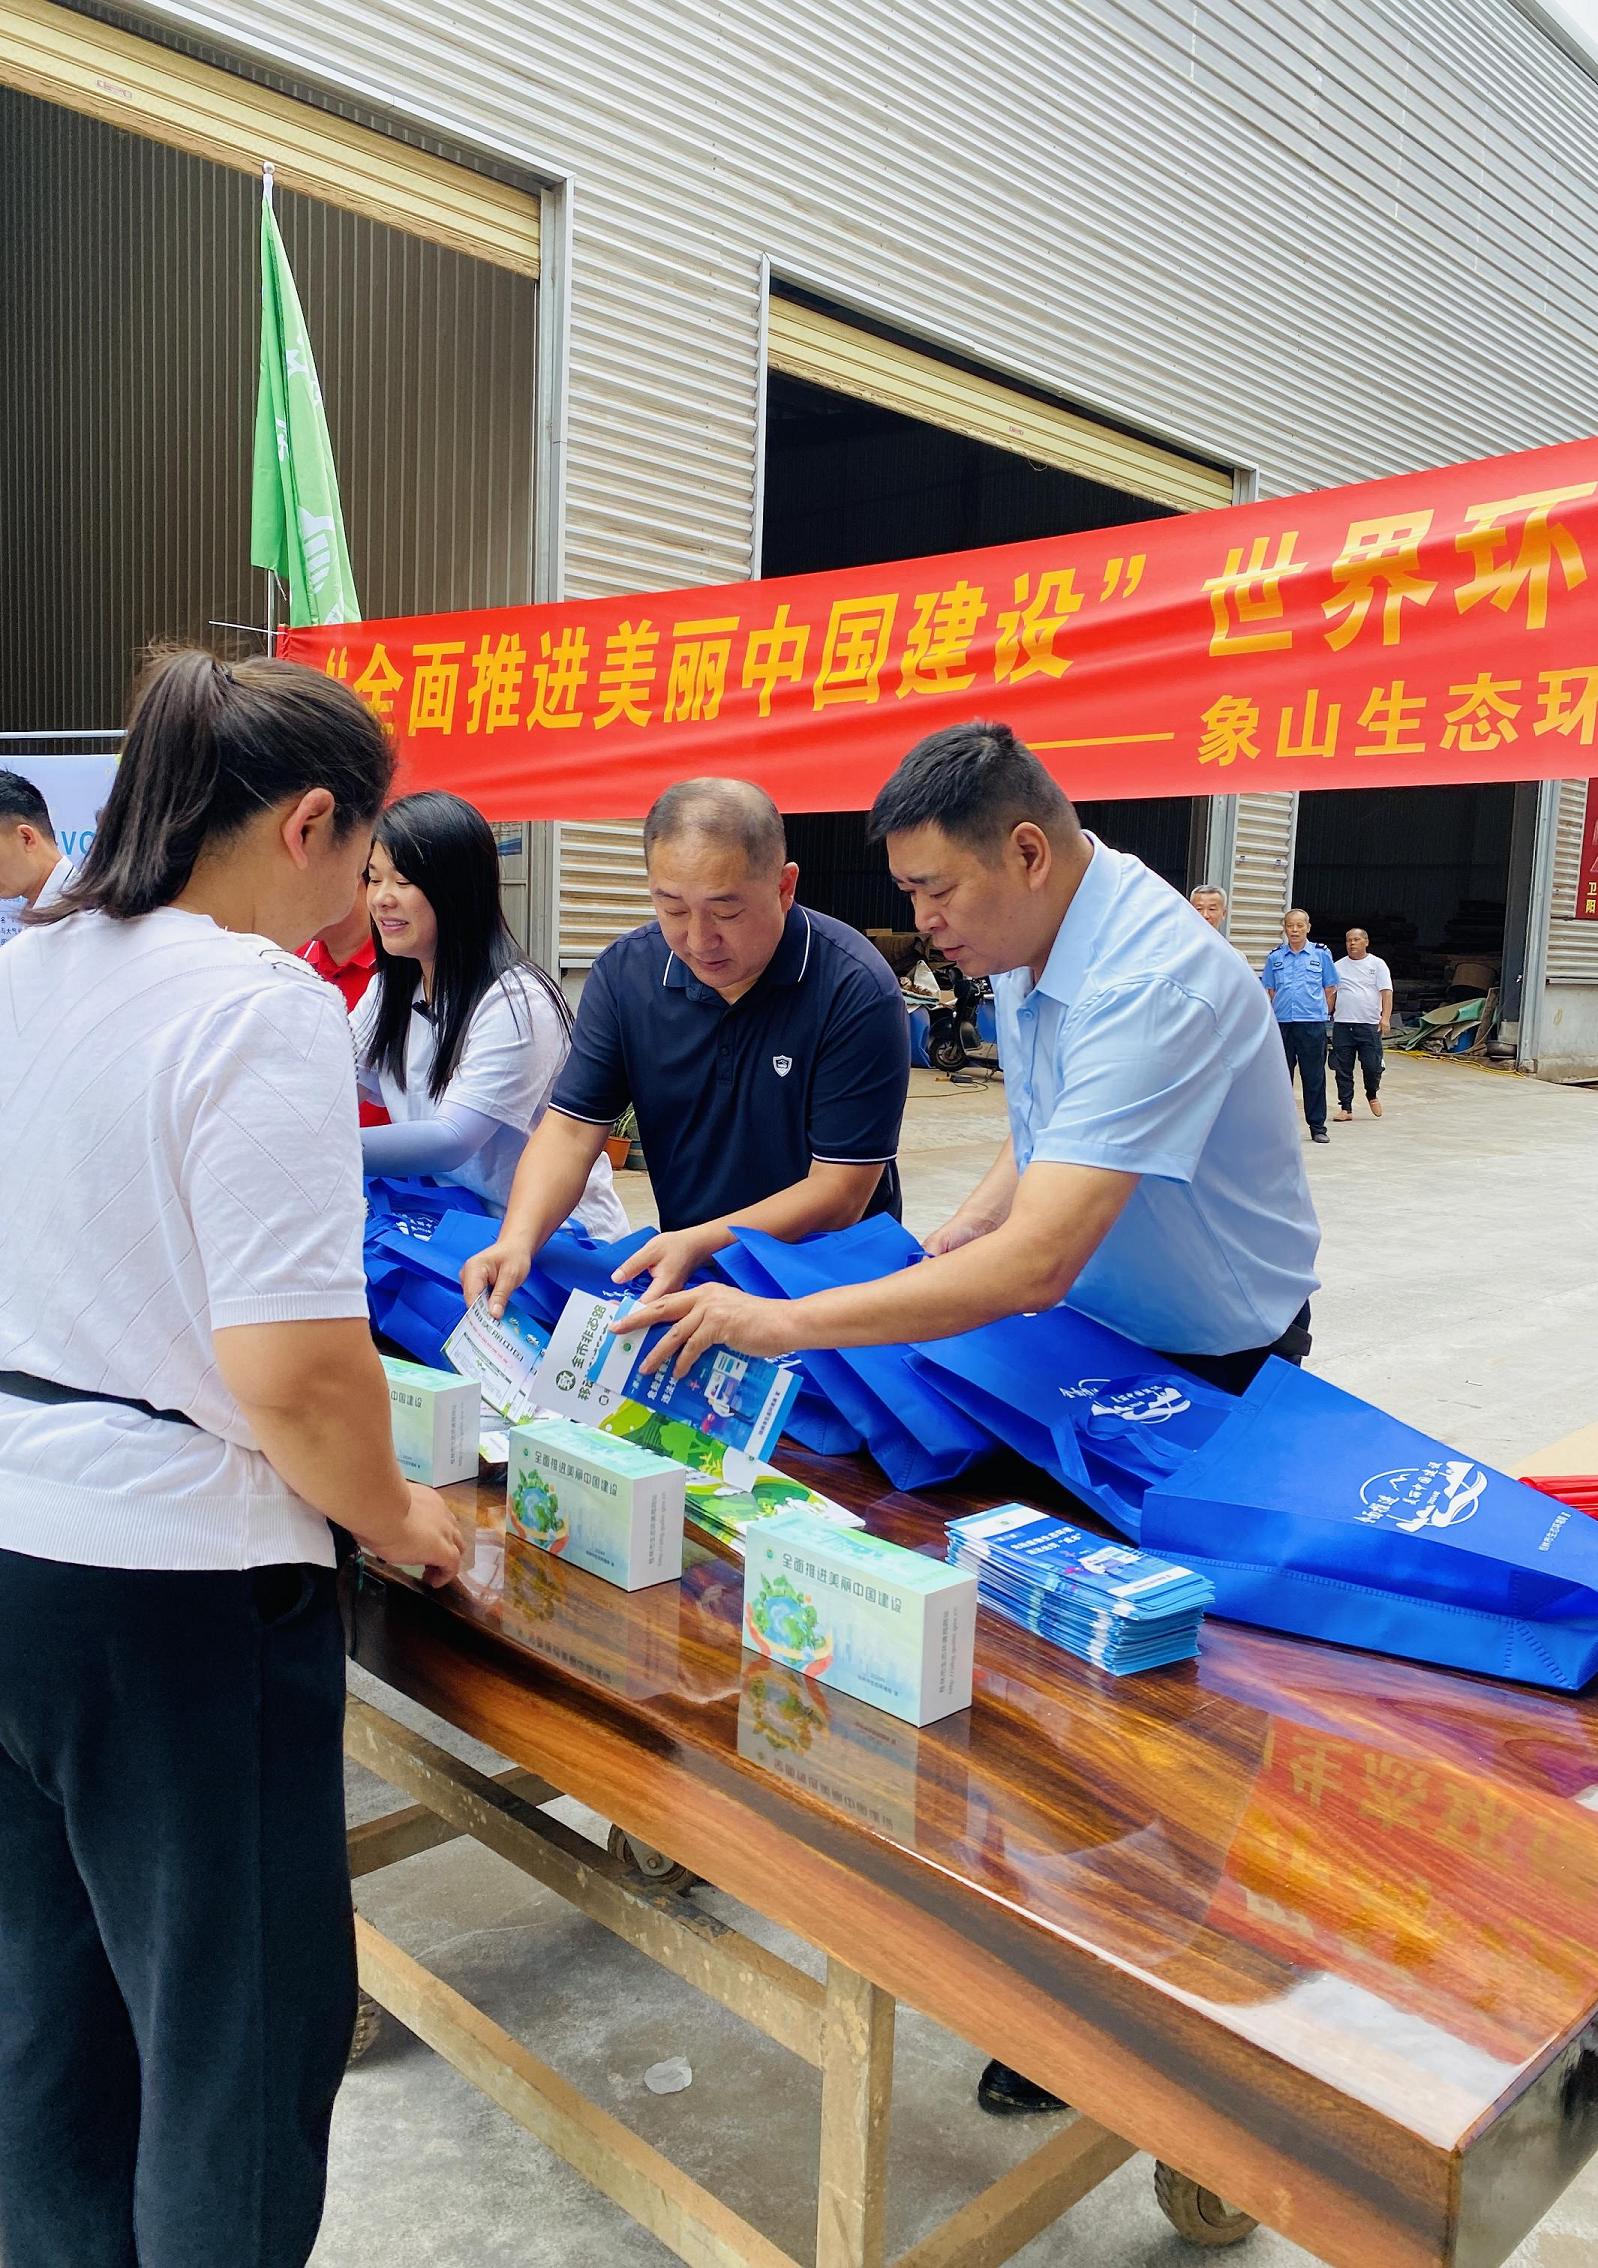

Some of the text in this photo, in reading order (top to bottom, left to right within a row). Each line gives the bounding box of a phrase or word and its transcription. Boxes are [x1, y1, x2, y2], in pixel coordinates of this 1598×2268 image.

[1201, 481, 1598, 657] 世界环
[533, 1449, 619, 1498] 全面推进美丽中国建设
[781, 1552, 903, 1616] 全面推进美丽中国建设
